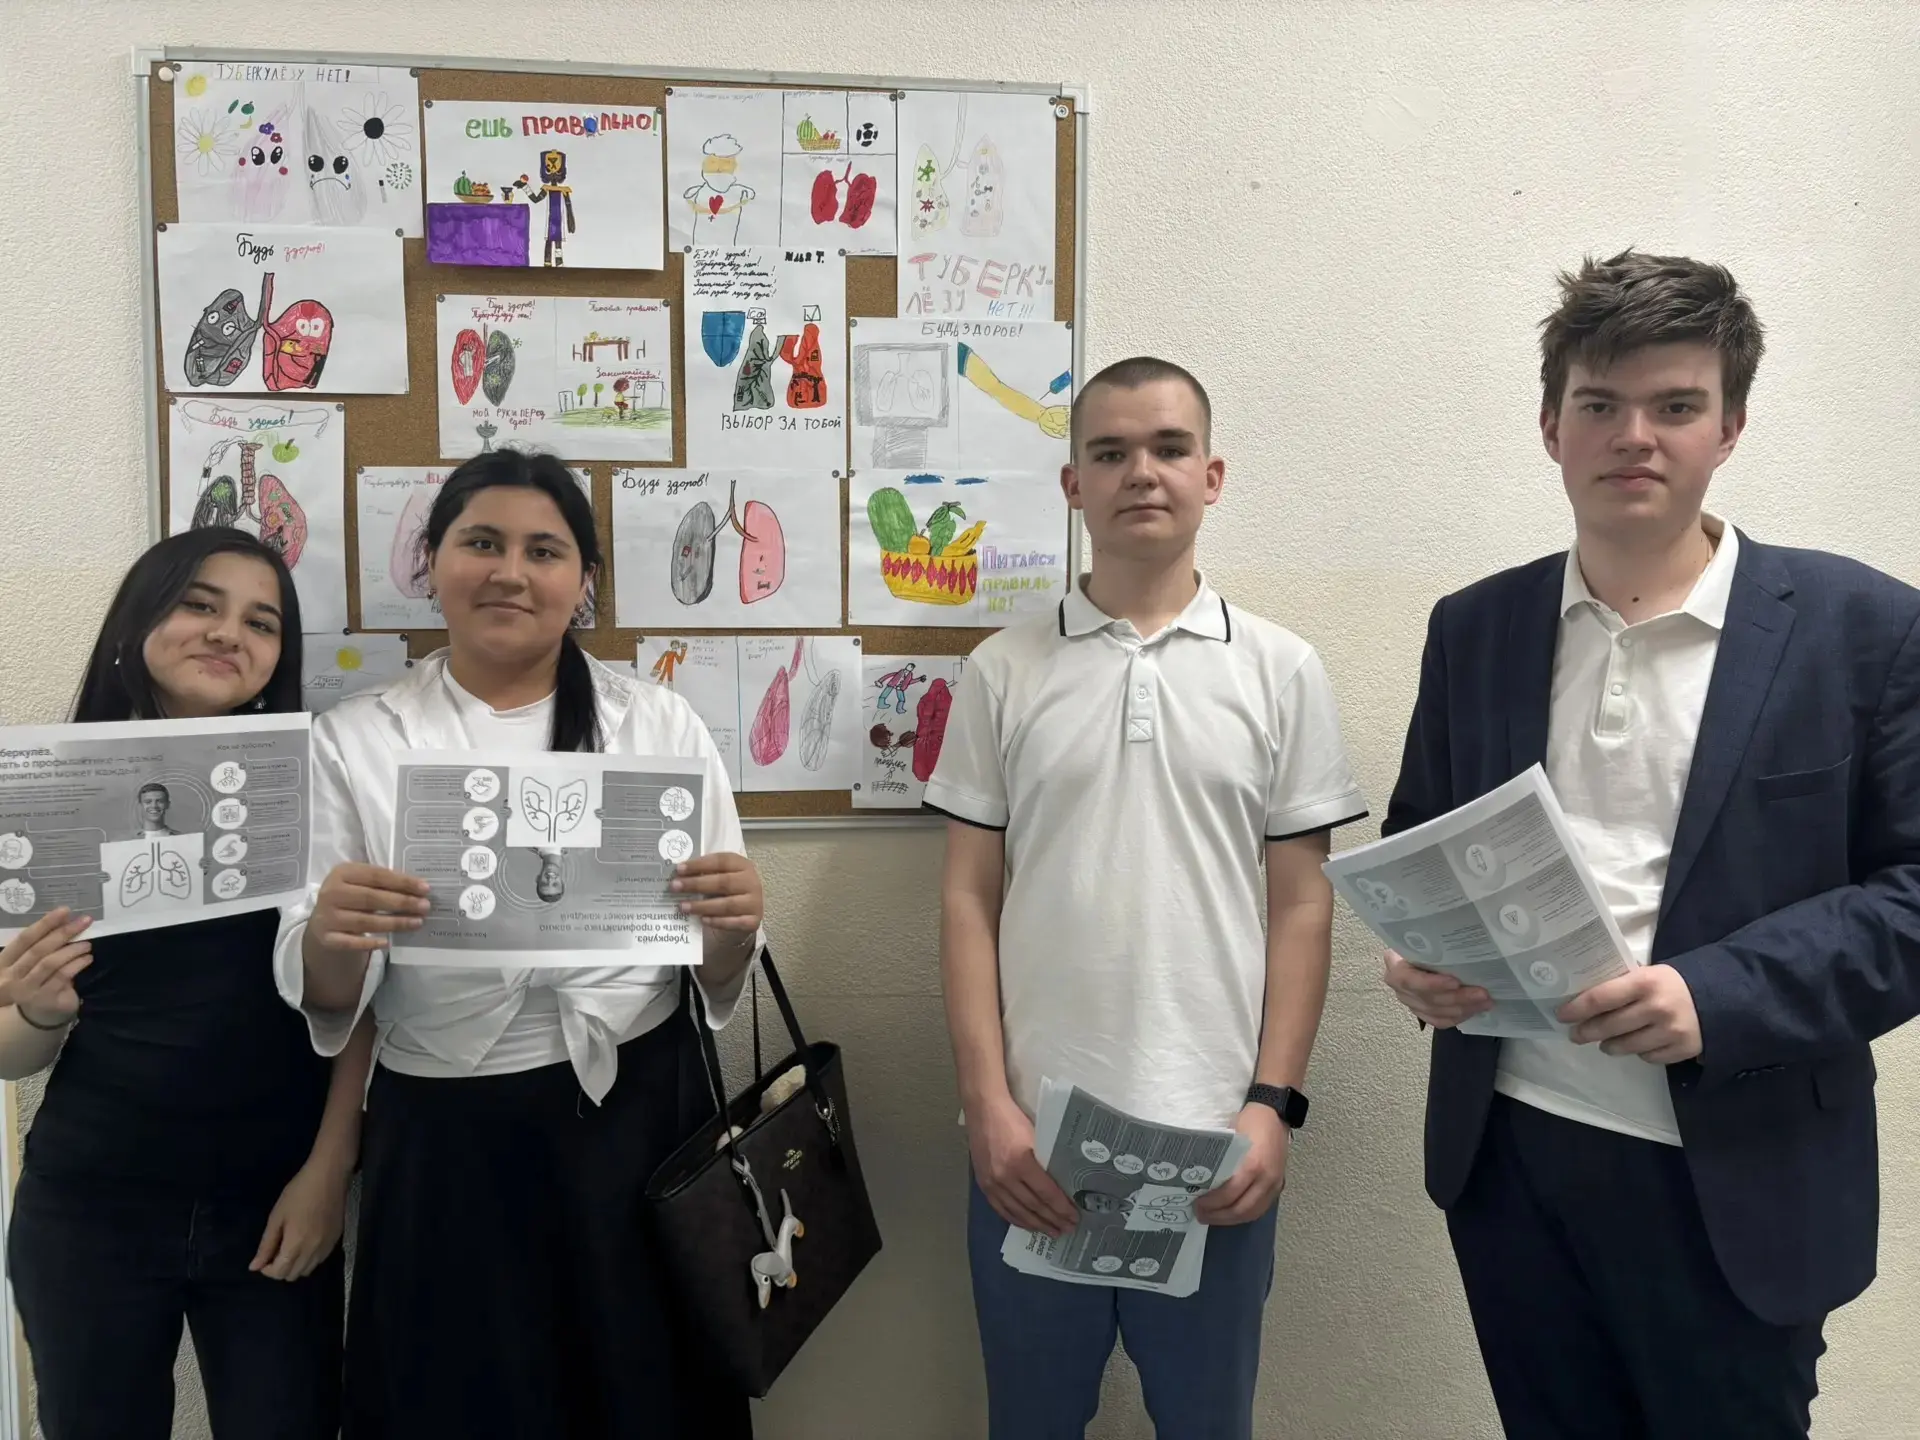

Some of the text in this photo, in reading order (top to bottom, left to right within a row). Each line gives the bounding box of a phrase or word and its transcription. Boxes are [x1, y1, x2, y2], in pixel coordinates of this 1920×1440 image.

[216, 63, 351, 84] ТУБЕРКУЛЁЗУ НЕТ!
[236, 233, 274, 264] Будь
[962, 323, 1024, 338] ЗДОРОВ!
[721, 413, 773, 431] ВЫБОР
[778, 415, 797, 431] ЗА
[619, 467, 709, 496] Будь здоров!
